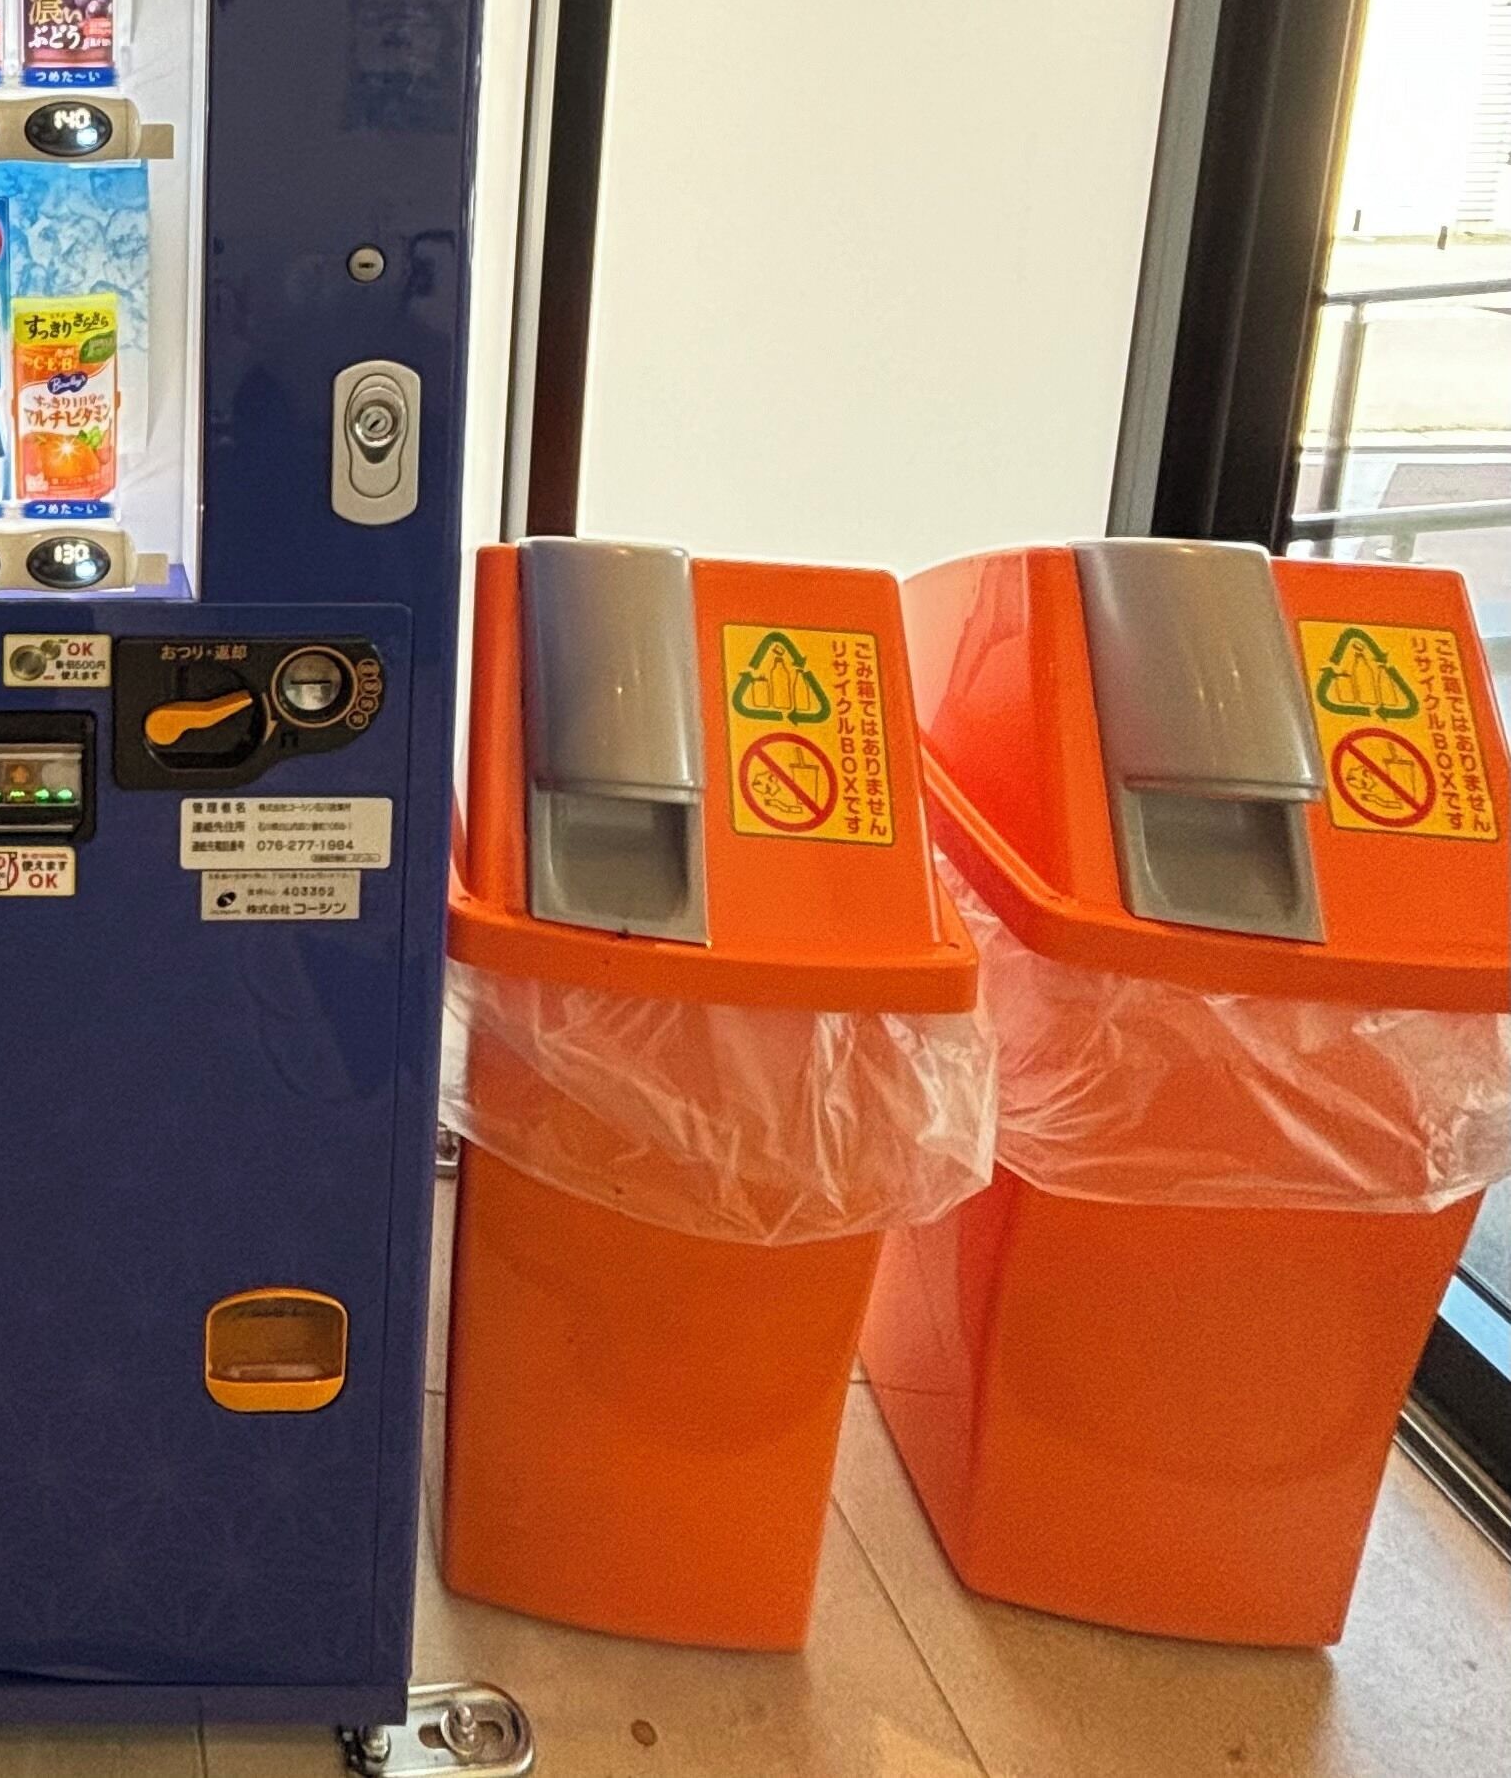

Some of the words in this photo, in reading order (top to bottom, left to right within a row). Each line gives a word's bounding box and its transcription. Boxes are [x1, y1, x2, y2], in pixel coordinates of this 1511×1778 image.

[28, 24, 82, 49] ぶどう
[53, 109, 91, 130] 140
[53, 543, 90, 564] 130
[67, 642, 94, 656] OK
[831, 640, 861, 835] リサイクルBOXです
[28, 873, 58, 889] OK
